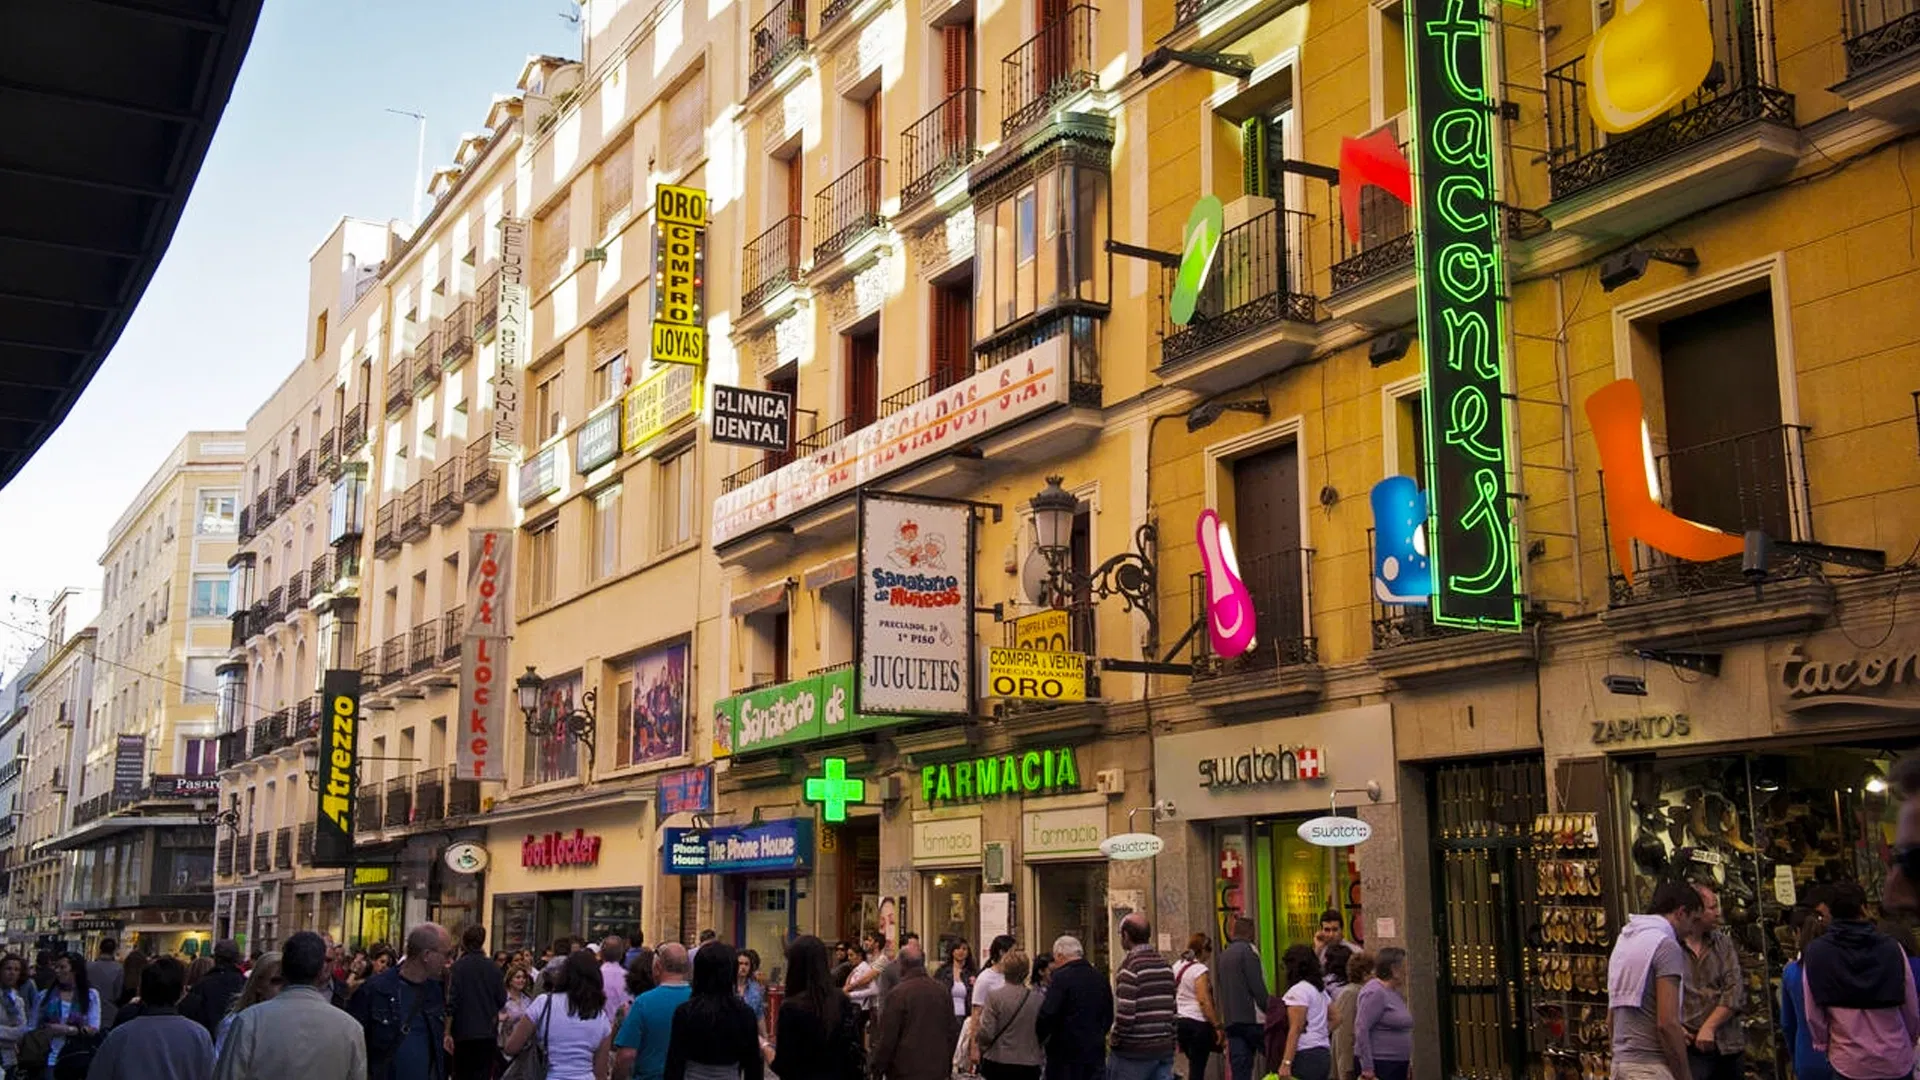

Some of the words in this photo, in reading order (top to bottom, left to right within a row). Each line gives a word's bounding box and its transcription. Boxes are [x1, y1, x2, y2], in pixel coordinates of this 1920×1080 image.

[660, 189, 703, 221] ORO
[669, 227, 690, 321] COMPRO
[1426, 0, 1511, 595] tacones
[656, 328, 700, 359] JOYAS
[715, 389, 788, 421] CLINICA
[715, 416, 785, 445] DENTAL
[872, 567, 959, 592] Sanatorio
[911, 634, 936, 645] PISO
[870, 655, 960, 693] JUGUETES
[990, 650, 1040, 668] COMPRA
[1049, 654, 1085, 671] VENTA
[990, 667, 1035, 677] PRECIO
[993, 676, 1064, 698] ORO
[739, 691, 815, 748] Sanatorio
[825, 684, 845, 724] de
[1591, 714, 1691, 744] ZAPATOS
[322, 695, 355, 833] Atrezzo
[922, 746, 1078, 801] FARMACIA
[1198, 744, 1298, 788] swatch
[922, 825, 973, 851] farmacia
[1311, 825, 1360, 838] swatch
[672, 843, 706, 855] Phone
[672, 854, 706, 866] House
[708, 841, 726, 862] The
[727, 837, 759, 860] Phone
[761, 834, 796, 857] House
